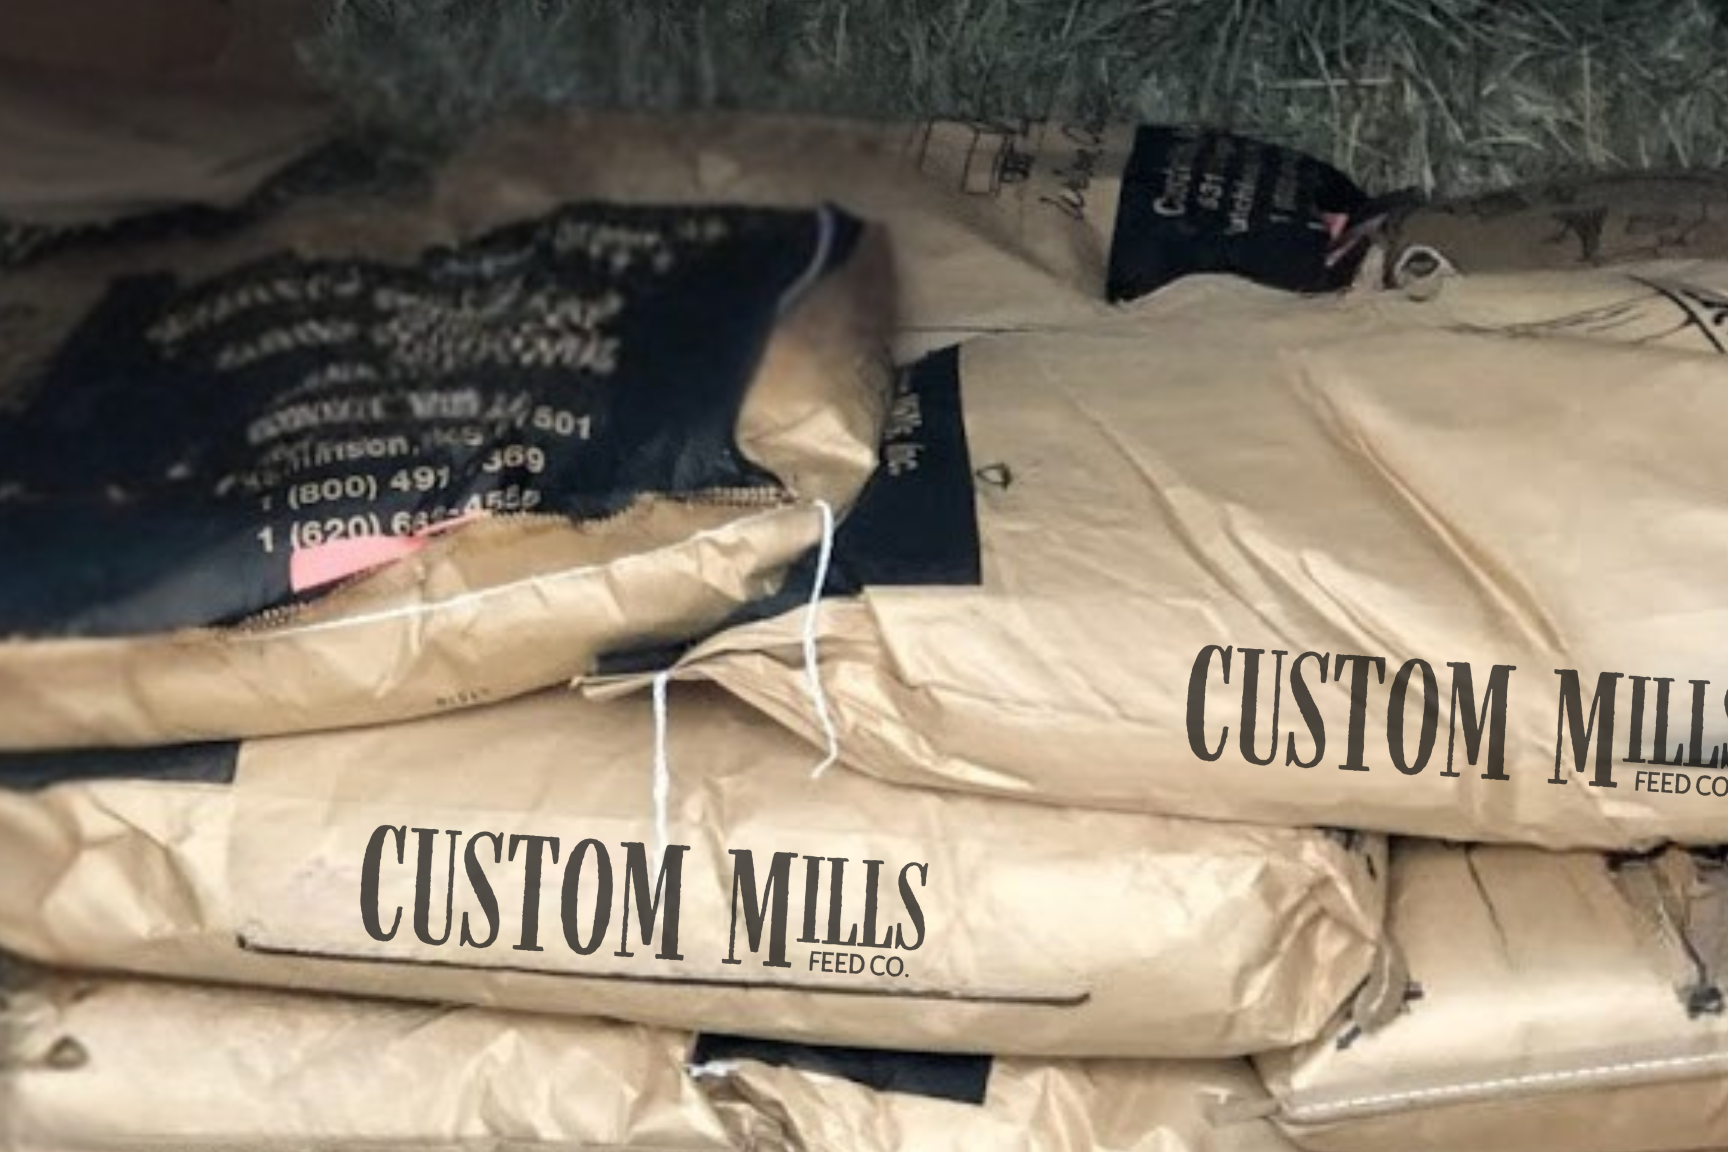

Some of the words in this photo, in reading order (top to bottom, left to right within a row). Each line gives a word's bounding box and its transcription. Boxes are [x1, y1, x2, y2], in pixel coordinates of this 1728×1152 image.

[288, 474, 378, 510] (800)
[256, 526, 274, 552] 1
[1187, 645, 1516, 780] CUSTOM
[1548, 669, 1728, 788] MILL
[1635, 771, 1691, 794] FEED
[361, 825, 691, 960] CUSTOM
[722, 850, 929, 968] MILLS
[809, 952, 865, 974] FEED
[870, 956, 910, 978] CO.
